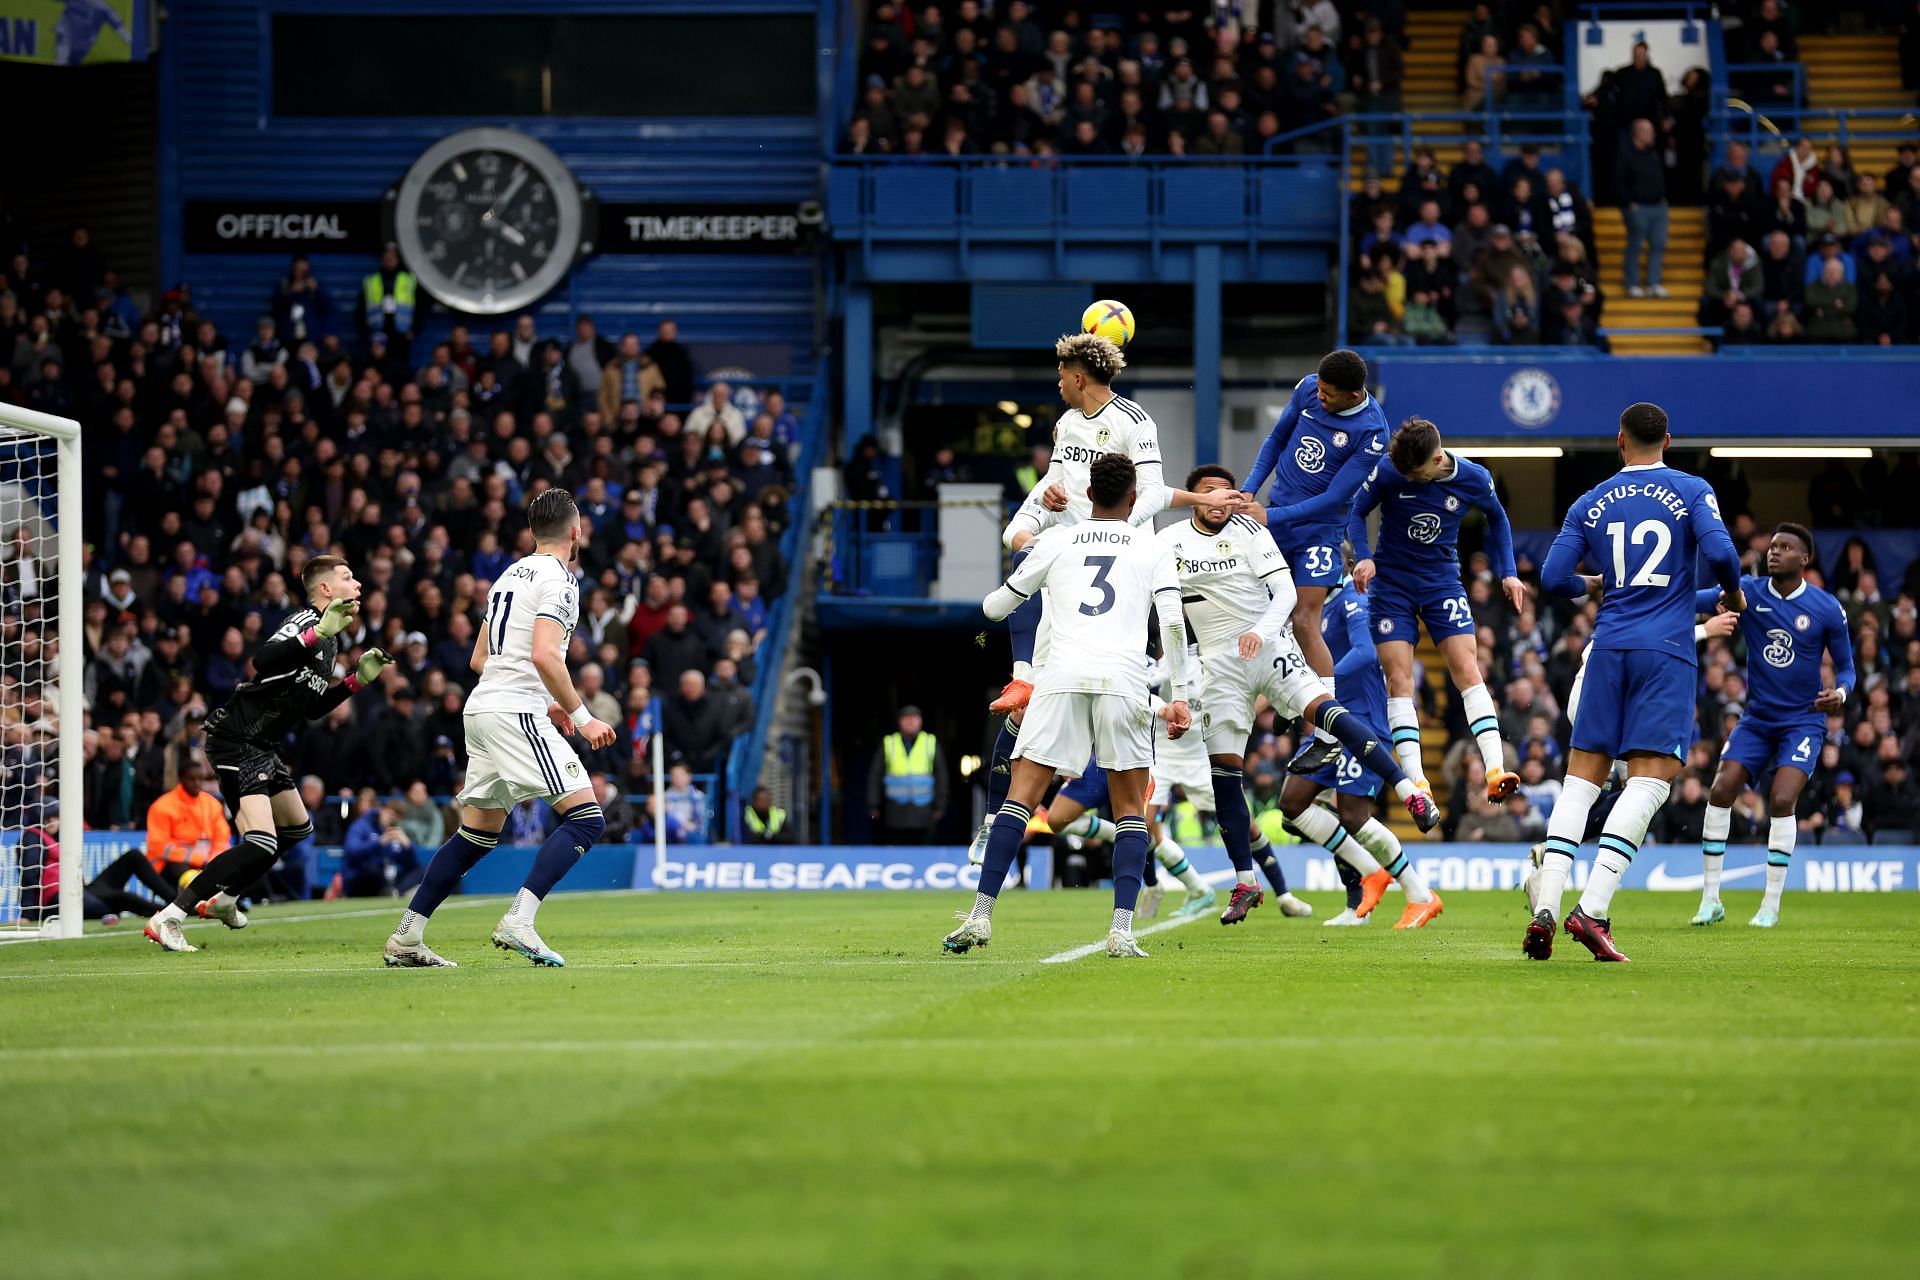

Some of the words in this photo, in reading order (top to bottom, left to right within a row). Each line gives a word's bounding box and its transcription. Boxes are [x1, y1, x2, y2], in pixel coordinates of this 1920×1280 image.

[216, 213, 348, 239] OFFICIAL
[625, 215, 797, 241] TIMEKEEPER
[1584, 483, 1689, 529] LOFTUS-CHEEK
[1072, 531, 1132, 546] JUNIOR
[1305, 545, 1333, 571] 33
[1606, 519, 1672, 589] 12
[508, 566, 538, 582] SON
[1079, 555, 1117, 616] 3
[1443, 597, 1472, 622] 29
[488, 591, 514, 655] 11
[1273, 653, 1306, 679] 28
[1797, 736, 1812, 758] 4
[1335, 754, 1363, 778] 26
